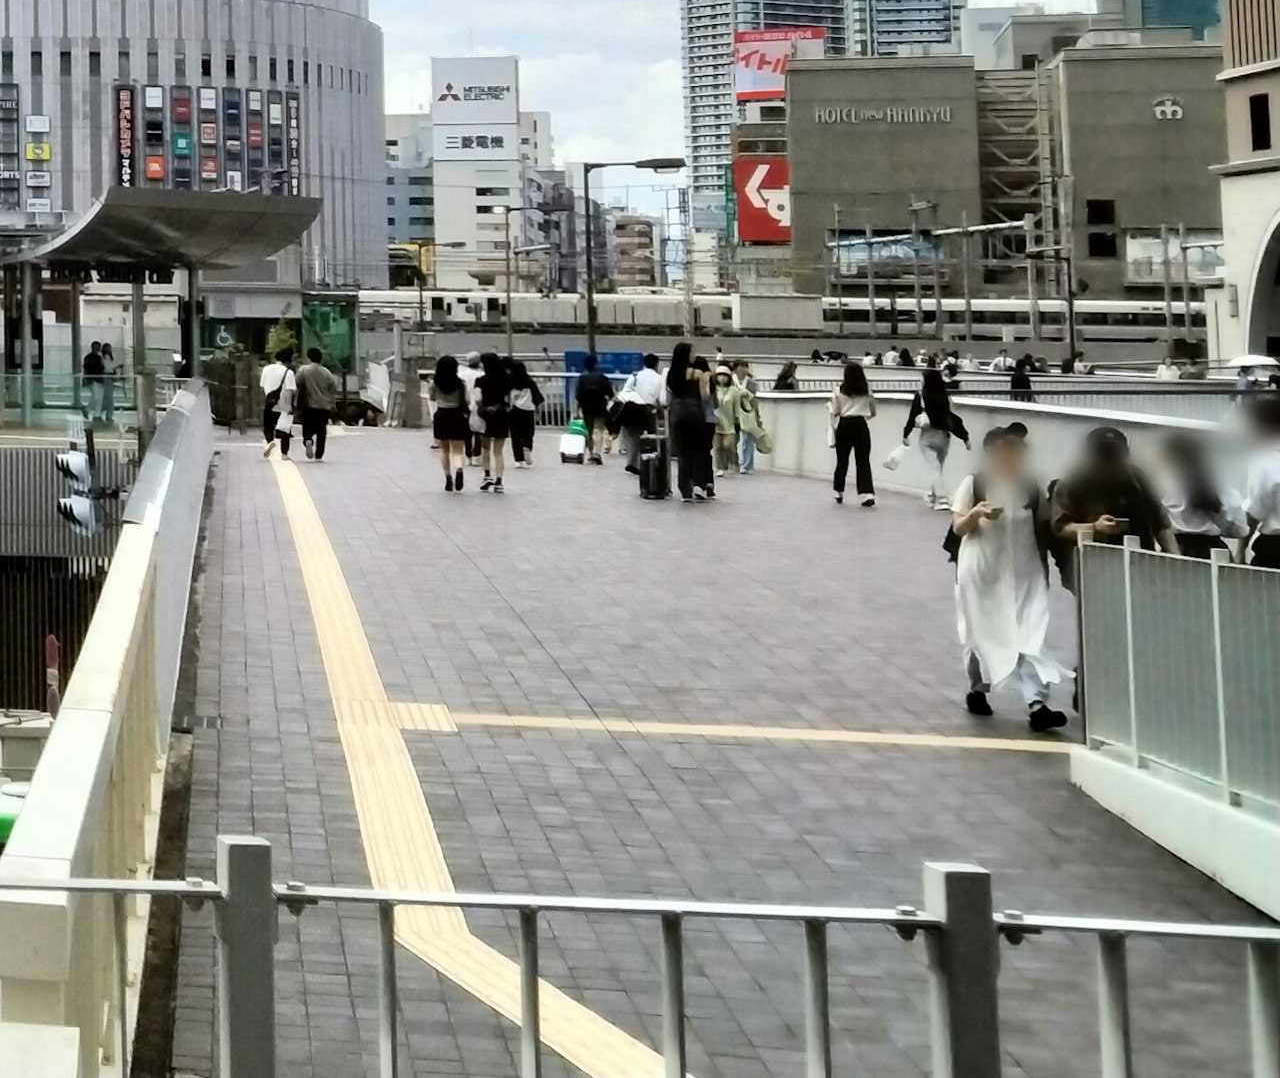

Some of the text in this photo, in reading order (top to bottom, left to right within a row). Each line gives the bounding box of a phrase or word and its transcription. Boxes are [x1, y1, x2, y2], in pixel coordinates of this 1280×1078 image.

[463, 85, 510, 93] MITSUBISHI
[463, 93, 504, 101] ELECTRIC
[815, 106, 859, 123] HOTEL
[445, 135, 504, 149] 三菱電機
